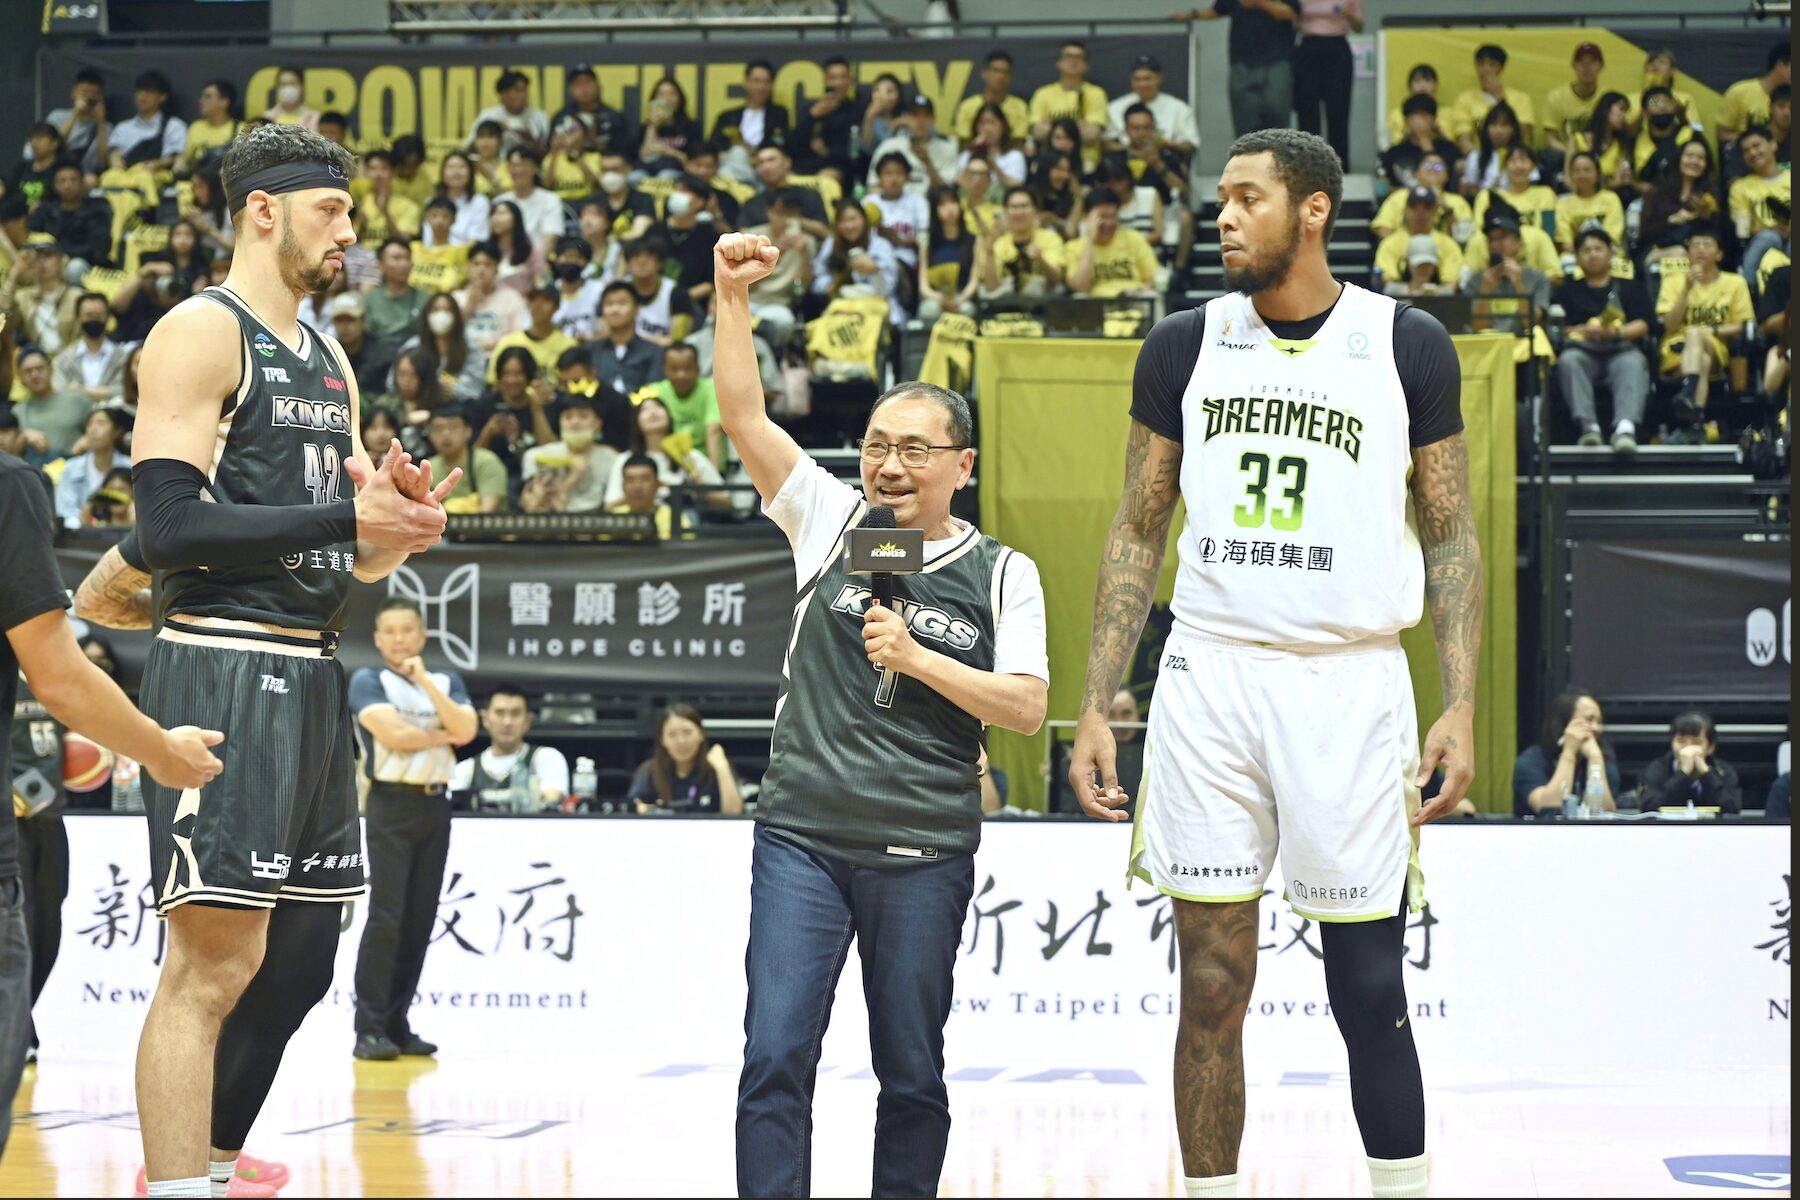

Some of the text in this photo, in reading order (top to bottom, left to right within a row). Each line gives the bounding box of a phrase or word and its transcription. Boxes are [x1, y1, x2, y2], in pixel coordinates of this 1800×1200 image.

[773, 60, 974, 150] CTY
[272, 396, 352, 436] KINGS
[1202, 396, 1364, 466] DREAMERS
[303, 442, 342, 505] 42
[1233, 451, 1308, 532] 33
[870, 548, 907, 558] KINGS
[1221, 538, 1334, 572] 海碩集團
[508, 581, 747, 626] 醫願診所
[829, 583, 980, 651] KNGS
[629, 637, 746, 657] CLINIC
[82, 983, 151, 1003] New
[410, 989, 588, 1008] overnment
[950, 997, 991, 1014] ew
[1009, 992, 1119, 1020] Taipei
